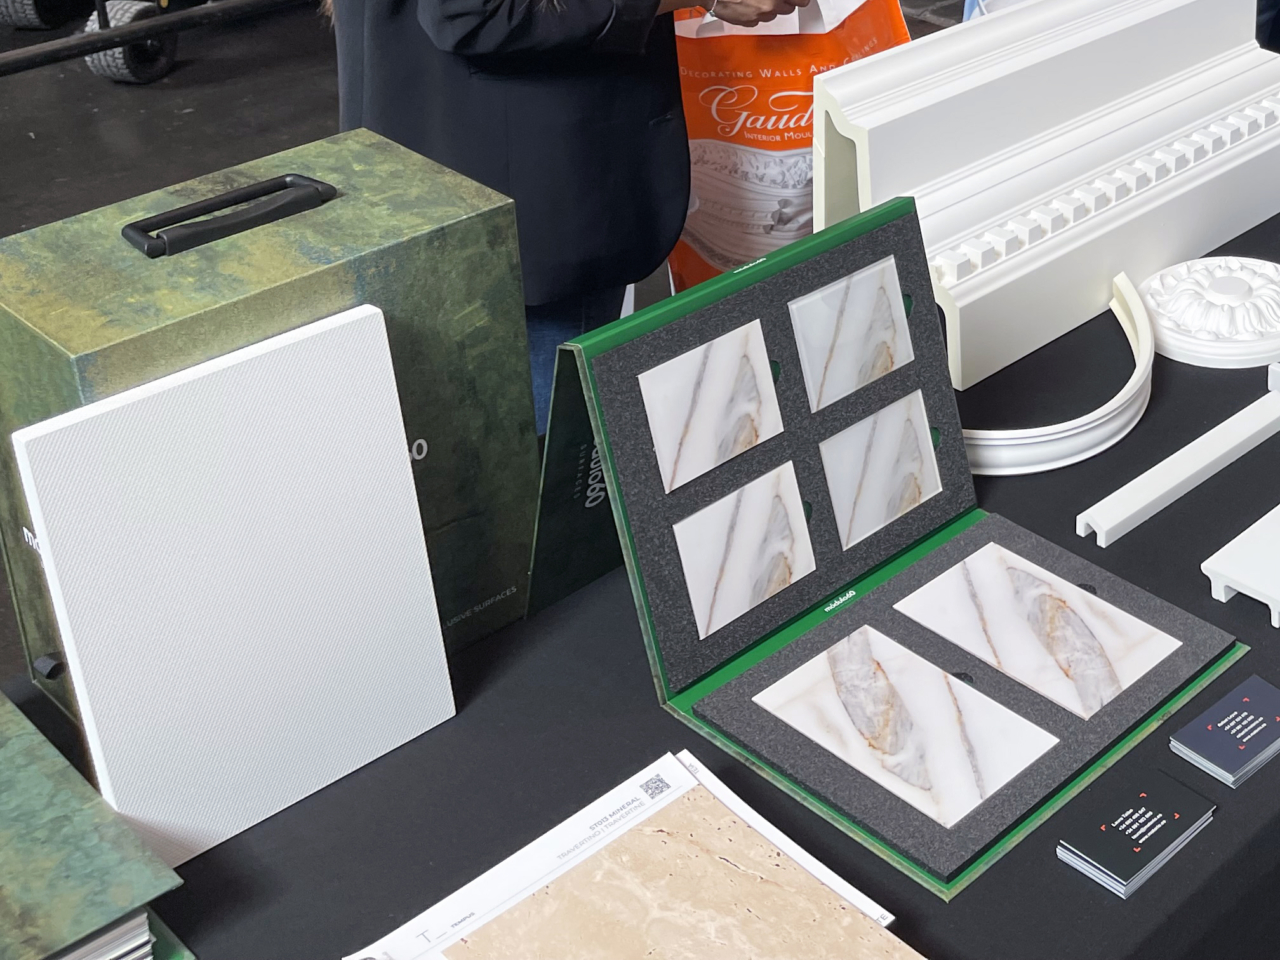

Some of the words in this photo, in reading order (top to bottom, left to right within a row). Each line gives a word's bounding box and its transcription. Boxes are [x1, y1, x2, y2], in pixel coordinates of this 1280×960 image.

[680, 67, 753, 79] DECORATING
[758, 68, 802, 78] WALLS
[809, 64, 836, 74] AND
[698, 84, 814, 137] Gaud
[744, 131, 781, 142] INTERIOR
[784, 131, 814, 141] MOUL
[446, 608, 473, 627] USIVE
[473, 585, 518, 613] SURFACES
[557, 830, 602, 860] TRAVERTINO
[603, 800, 646, 830] TRAVERTINE
[589, 816, 608, 831] ST013
[609, 796, 641, 818] MINERAL
[450, 912, 476, 928] TEMPUS
